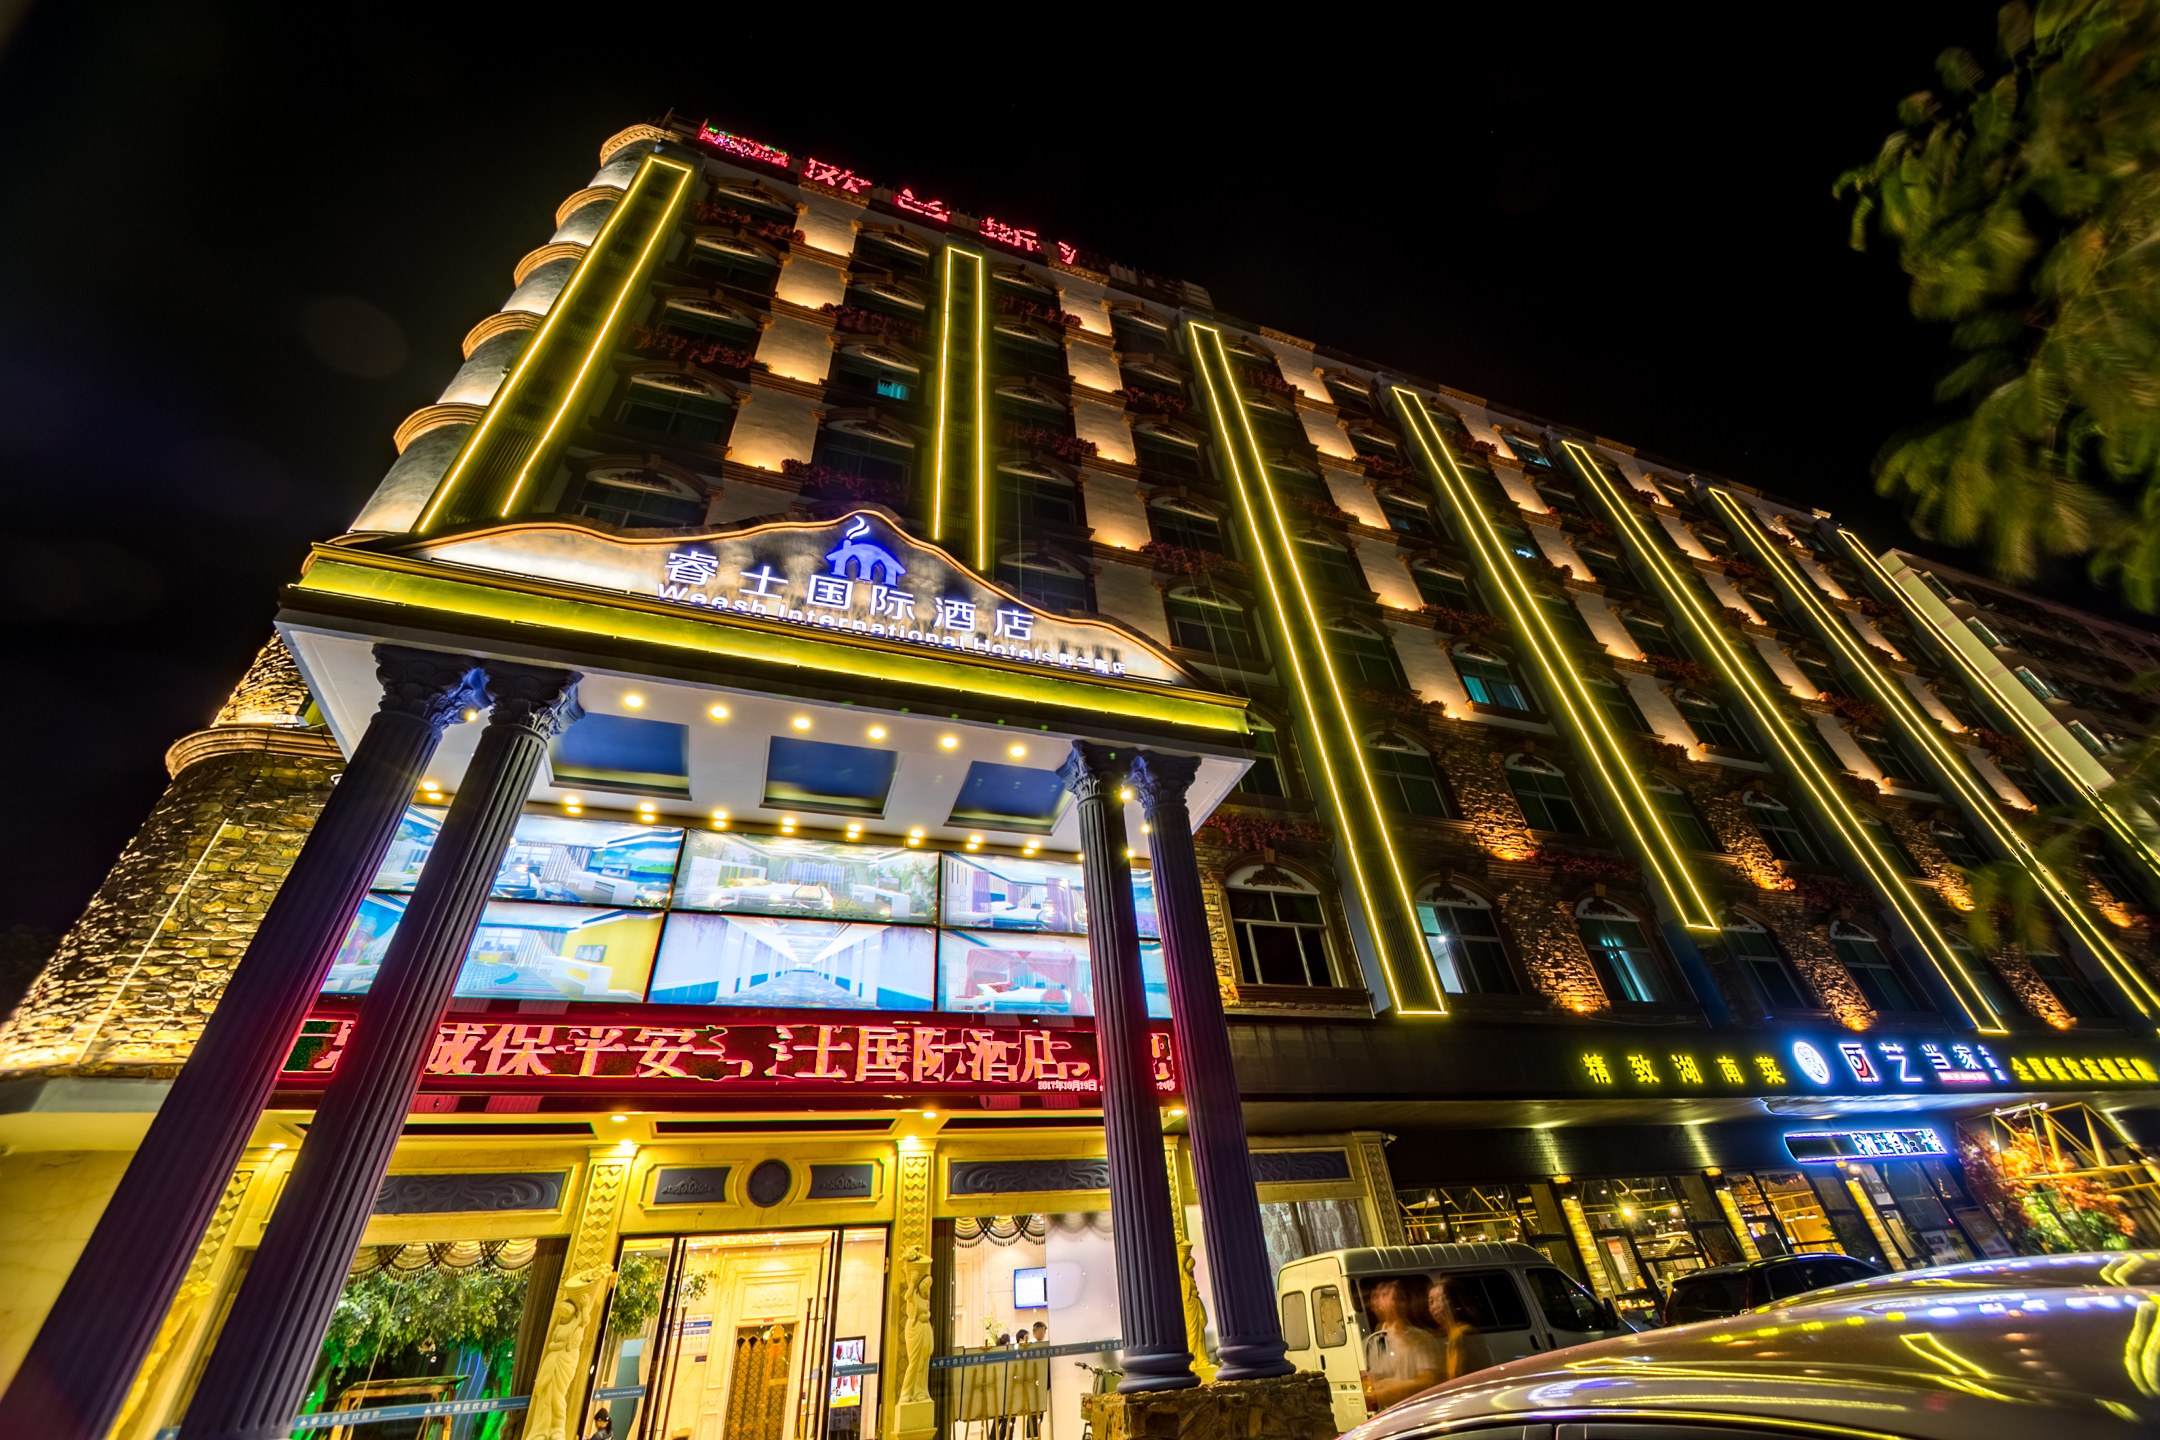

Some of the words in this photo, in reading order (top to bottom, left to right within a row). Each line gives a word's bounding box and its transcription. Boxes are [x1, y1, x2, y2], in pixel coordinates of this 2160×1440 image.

[664, 550, 1034, 642] 睿士国际酒店
[657, 583, 768, 616] Weesh
[777, 604, 966, 651] International
[973, 637, 1054, 664] Hotels
[1582, 1053, 1787, 1085] 精致湖南菜
[2010, 1056, 2160, 1082] 全国餐饮连锁品牌
[1037, 1079, 1098, 1092] 2017年10月19日
